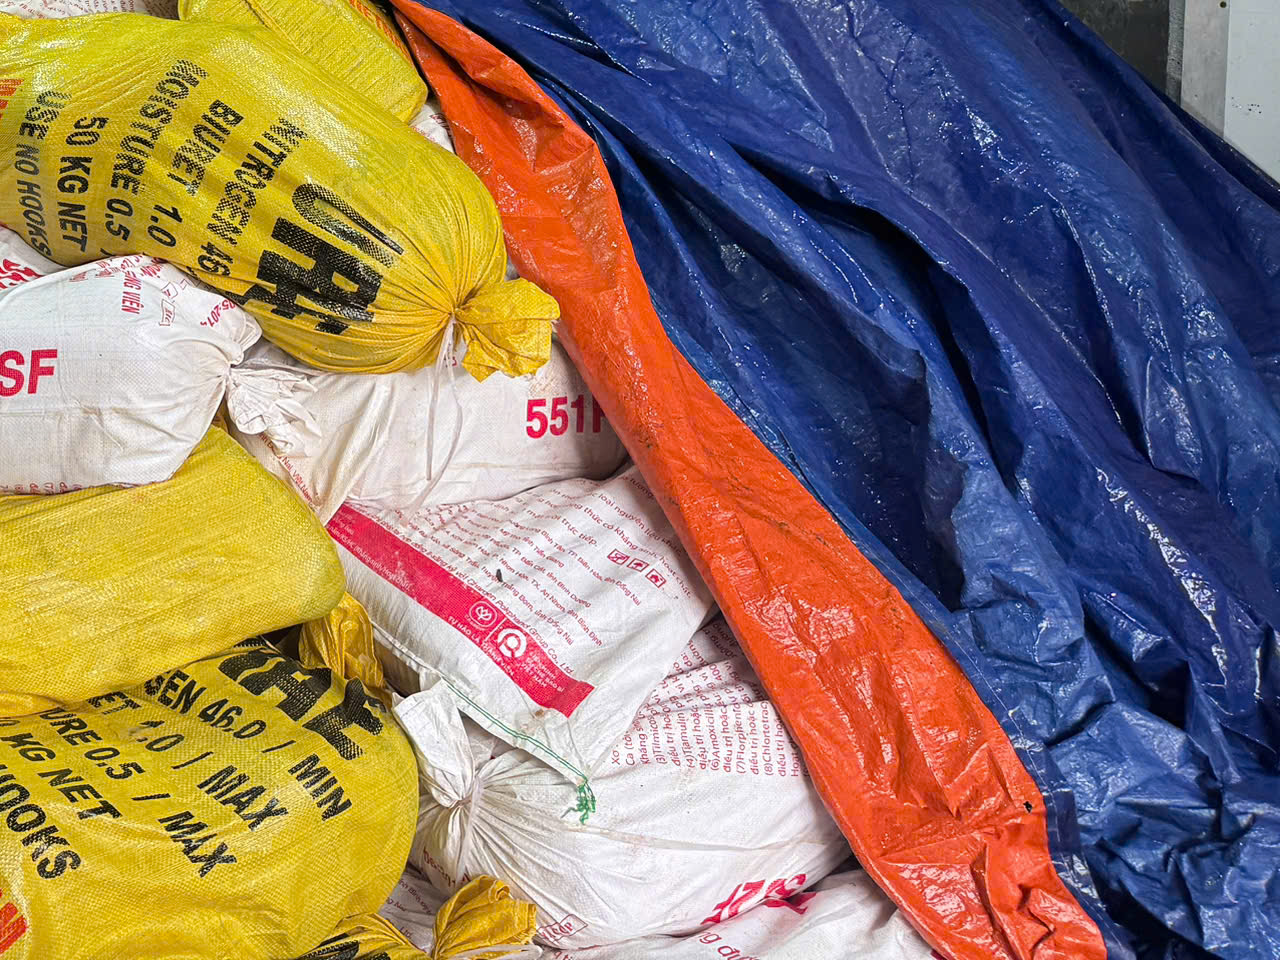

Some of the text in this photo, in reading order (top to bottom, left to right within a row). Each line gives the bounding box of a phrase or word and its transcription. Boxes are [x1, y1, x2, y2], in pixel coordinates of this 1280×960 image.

[15, 90, 72, 257] USE NO HOOKS
[57, 116, 110, 252] 50 KG NET
[111, 59, 209, 196] MOISTURE
[147, 100, 245, 248] BIURET 1.0
[207, 117, 308, 246] NITROGEN
[105, 198, 134, 241] 0.5
[526, 393, 605, 439] 551
[562, 518, 600, 549] trực tiếp.
[1, 731, 122, 821] KG NET
[139, 720, 186, 753] 1.0
[171, 751, 214, 770] /
[196, 765, 289, 831] MAX
[196, 698, 267, 740] 46.0
[261, 740, 297, 754] /
[287, 752, 352, 821] MIN
[626, 752, 636, 766] Ca
[756, 700, 776, 776] (8)Chlortetrac
[82, 746, 148, 782] 0.5
[132, 792, 171, 807] /
[159, 810, 238, 878] MAX
